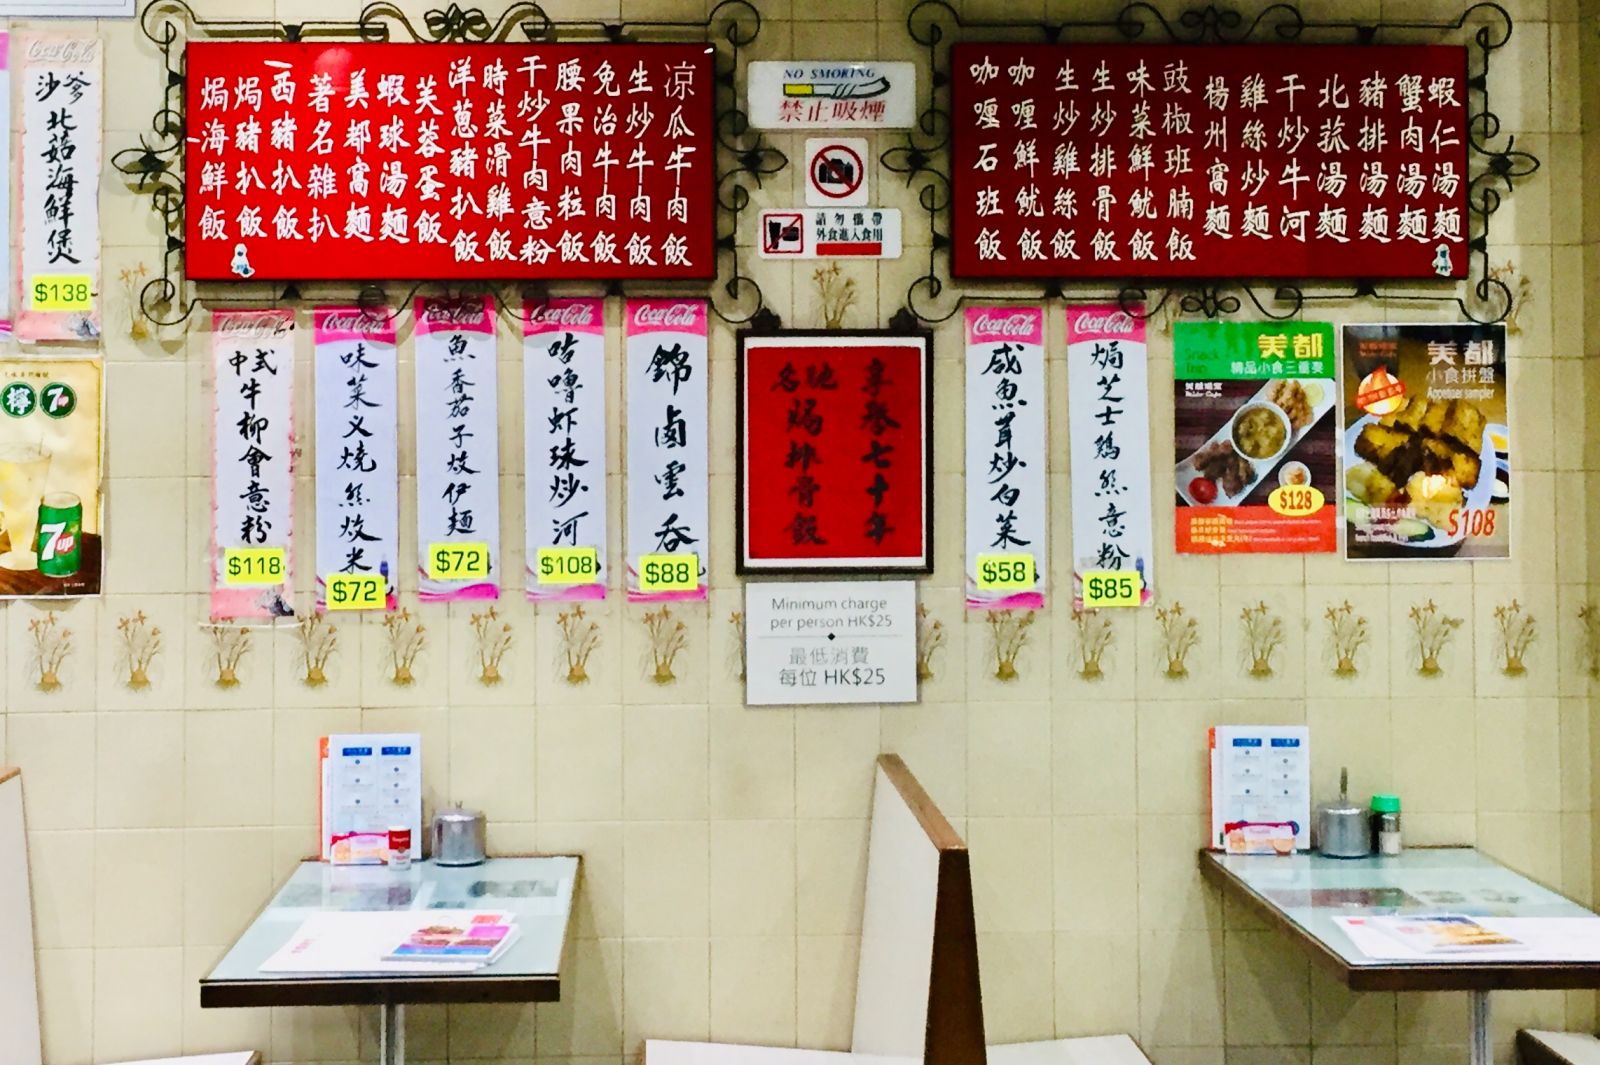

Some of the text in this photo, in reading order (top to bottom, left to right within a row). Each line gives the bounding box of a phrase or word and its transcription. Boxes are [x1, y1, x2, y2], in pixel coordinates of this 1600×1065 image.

[778, 100, 886, 122] 禁止吸煙
[783, 68, 875, 79] NO SMOKING
[199, 77, 229, 240] 焗海鮮飯
[234, 77, 267, 237] 焗豬扒飯
[307, 72, 340, 242] 著名雜扒
[377, 74, 411, 243] 蝦球湯麵
[413, 75, 447, 243] 芙蓉蛋飯
[483, 58, 517, 261] 時菜滑雞飯
[515, 55, 556, 265] 干炒牛肉意粉
[555, 58, 589, 262] 腰果肉粒飯
[590, 60, 621, 263] 免治牛肉飯
[624, 61, 657, 265] 生炒牛肉飯
[1008, 58, 1048, 260] 咖喱鮮魷飯
[1050, 60, 1080, 259] 生炒雞絲飯
[1089, 60, 1120, 261] 生炒排骨飯
[1127, 60, 1158, 260] 味菜鮮魷飯
[1241, 73, 1273, 239] 雞絲炒麵
[1276, 74, 1310, 242] 干炒牛河
[1358, 71, 1391, 243] 豬排湯麵
[1395, 74, 1431, 243] 蟹肉湯麵
[1428, 78, 1463, 242] 蝦仁湯麵
[35, 283, 87, 302] $138
[1258, 333, 1324, 358] 美都
[1427, 340, 1494, 365] 美都
[229, 557, 280, 576] $118
[437, 550, 479, 573] $72
[541, 557, 591, 575] $108
[646, 562, 689, 585] $88
[983, 562, 1025, 584] $58
[1280, 490, 1312, 510] $128
[333, 580, 376, 602] $72
[770, 614, 892, 631] per person HK$25
[771, 597, 887, 613] Minimum charge
[789, 646, 870, 665] 最低消費
[1089, 577, 1132, 600] $85
[779, 667, 886, 686] 每位 HK$25
